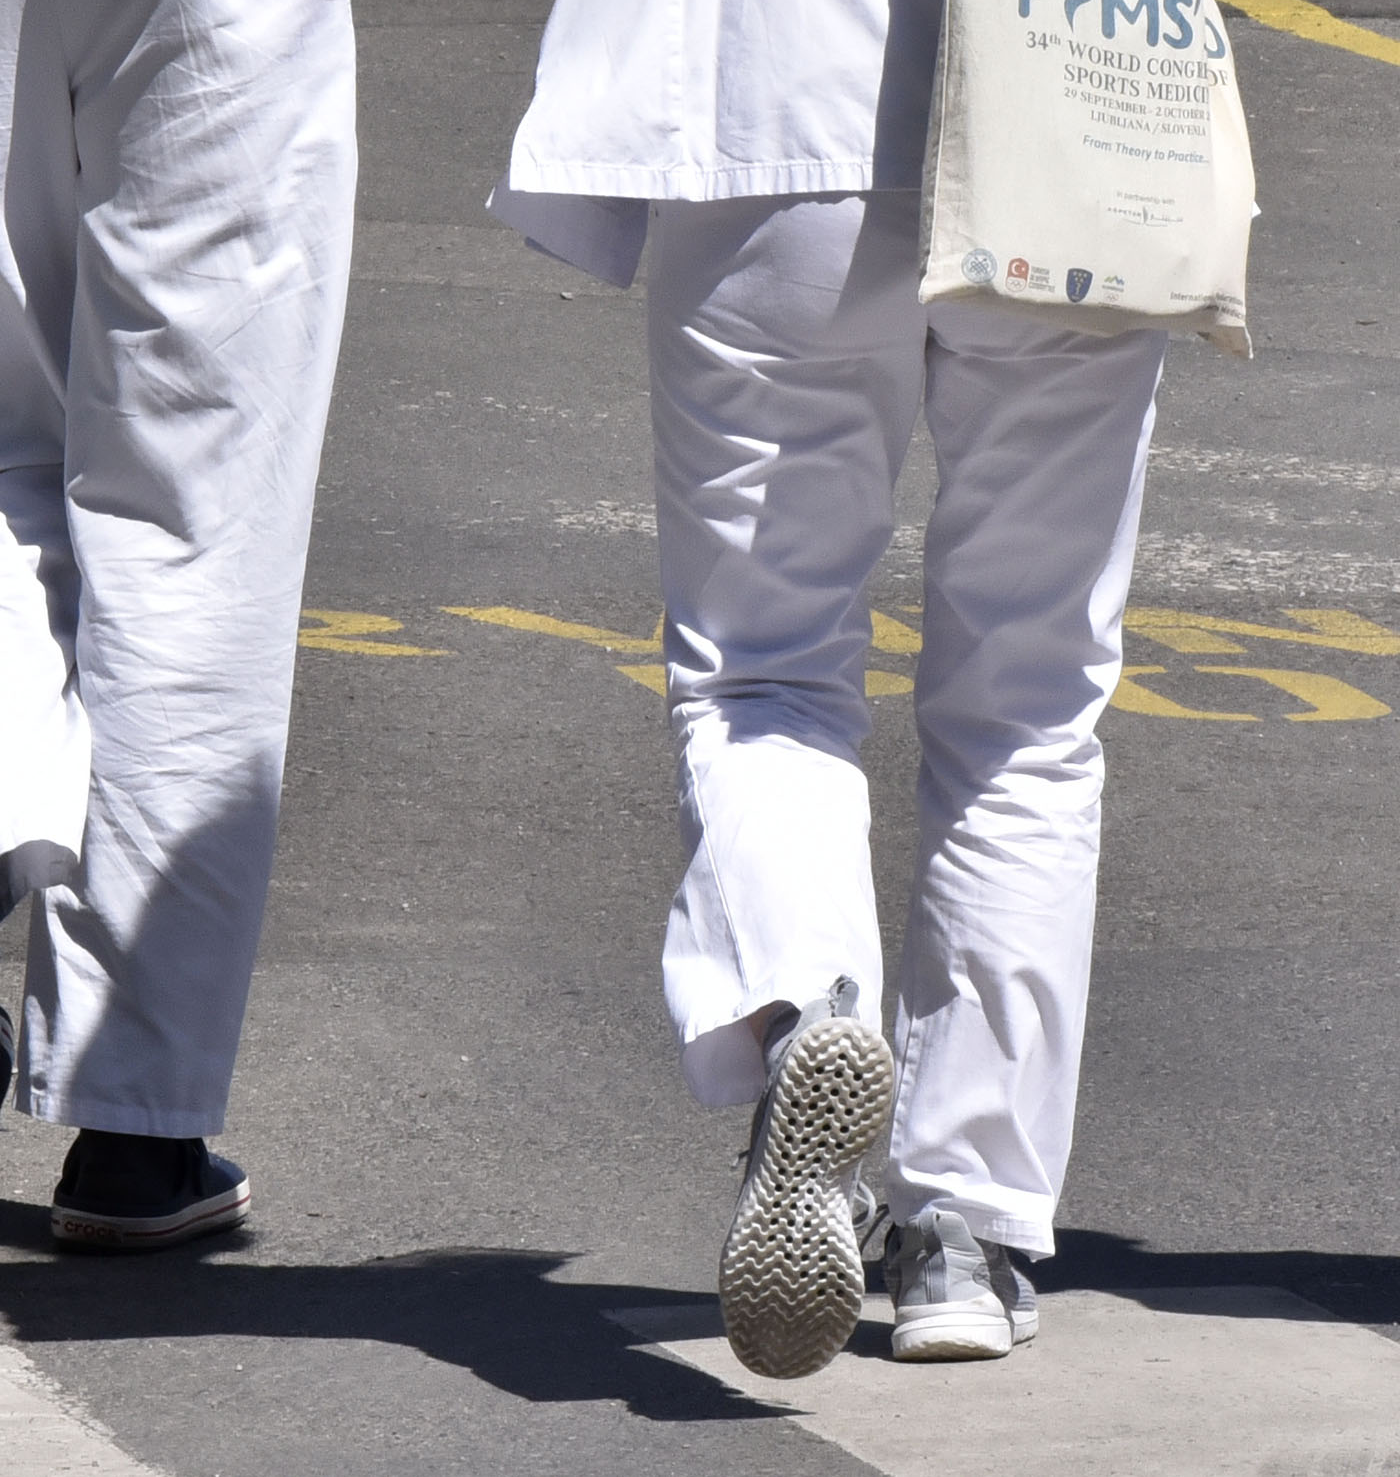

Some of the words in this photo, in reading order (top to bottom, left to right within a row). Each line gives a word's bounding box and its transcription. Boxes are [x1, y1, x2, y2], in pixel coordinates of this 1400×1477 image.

[1067, 39, 1141, 73] WORLD
[1064, 63, 1141, 98] SPORTS
[1080, 91, 1147, 115] SEPTEMBER
[1090, 110, 1151, 132] LJUBLJANA
[1082, 134, 1112, 152] From
[1115, 141, 1152, 161] Theory
[1154, 149, 1165, 160] to
